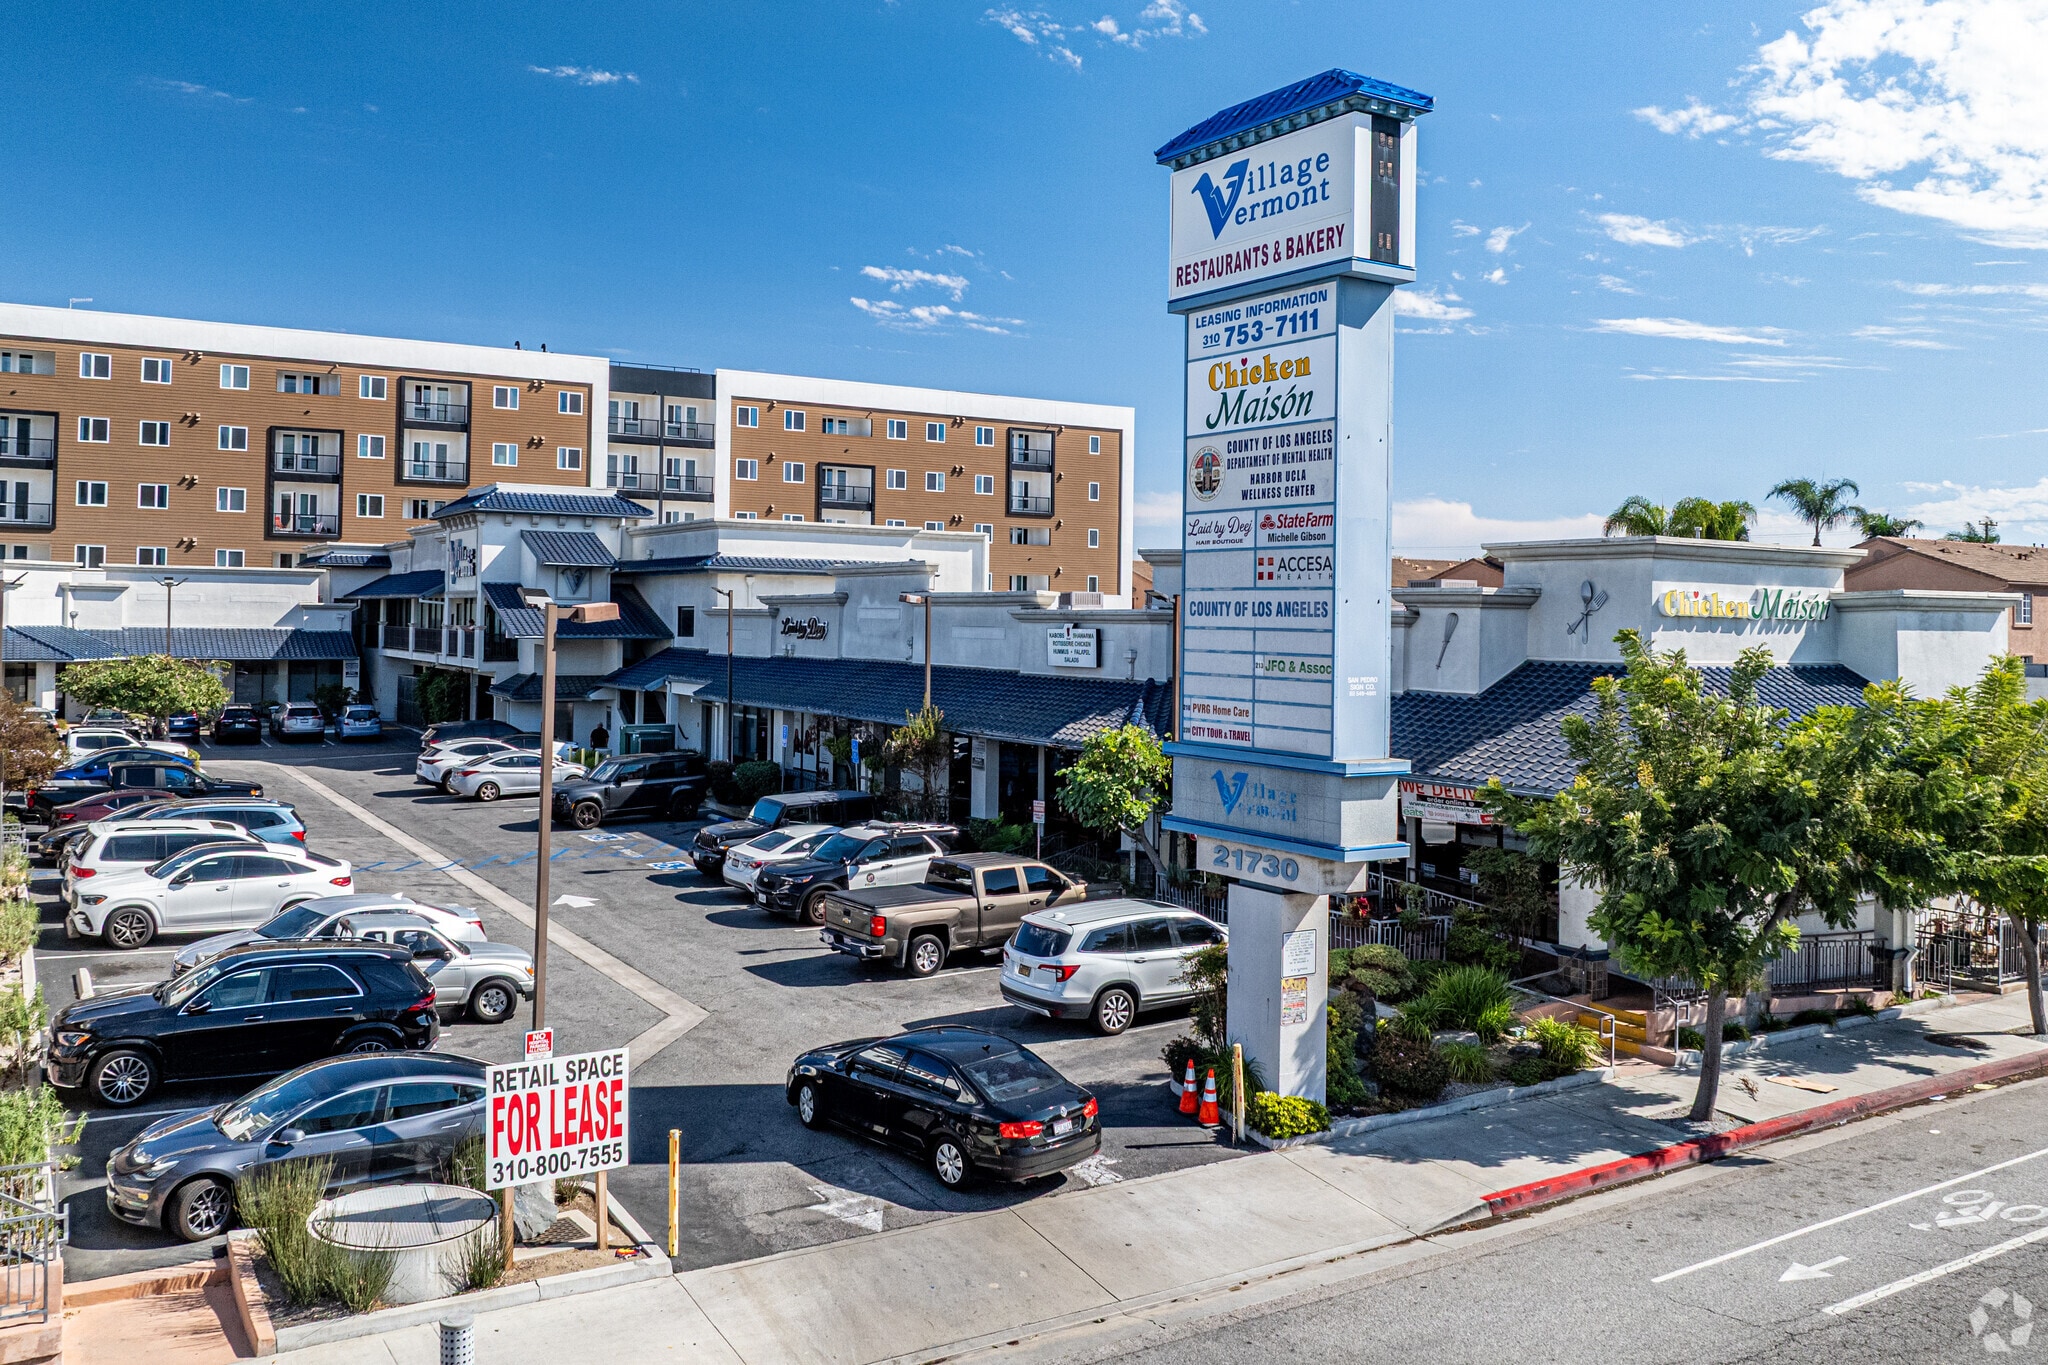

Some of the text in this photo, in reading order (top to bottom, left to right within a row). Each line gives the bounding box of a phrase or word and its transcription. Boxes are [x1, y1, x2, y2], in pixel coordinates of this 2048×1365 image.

[1191, 152, 1330, 234] Village
[1176, 223, 1346, 288] RESTAURANTS & BAKERY
[1196, 289, 1328, 329] LEASING INFORMATION
[1203, 308, 1319, 347] 310 753-7111
[1208, 354, 1311, 391] Chicken
[1227, 429, 1333, 454] COUNTY OF LOS ANGELES
[1272, 453, 1280, 466] OF
[1282, 450, 1306, 465] MENTAL
[1308, 447, 1333, 462] HEALTH
[1250, 469, 1306, 485] HARBOR UCLA
[1241, 484, 1315, 501] WELLNESS CENTER
[1188, 518, 1213, 537] Laid
[1214, 521, 1226, 539] by
[1268, 531, 1326, 543] Michelle Gibson
[1277, 556, 1333, 572] ACCESA
[1277, 573, 1333, 581] HEALTH
[1190, 601, 1329, 618] COUNTY OF LOS ANGELES
[1660, 589, 1749, 618] Chicken
[1288, 660, 1296, 673] &
[1299, 661, 1332, 675] Assoc
[1192, 703, 1211, 714] PVRG
[1212, 704, 1231, 716] Home
[1233, 706, 1250, 718] Care
[1191, 726, 1206, 737] CITY
[1207, 727, 1223, 739] TOUR
[1223, 731, 1228, 739] &
[1229, 729, 1251, 742] TRAVEL
[1401, 781, 1425, 795] WE
[1426, 796, 1467, 806] order online
[1403, 808, 1425, 817] eats
[1213, 844, 1300, 882] 21730
[532, 1032, 547, 1041] NO
[492, 1053, 623, 1094] RETAIL SPACE
[492, 1078, 623, 1159] FOR LEASE
[492, 1142, 623, 1184] 310-800-7555
